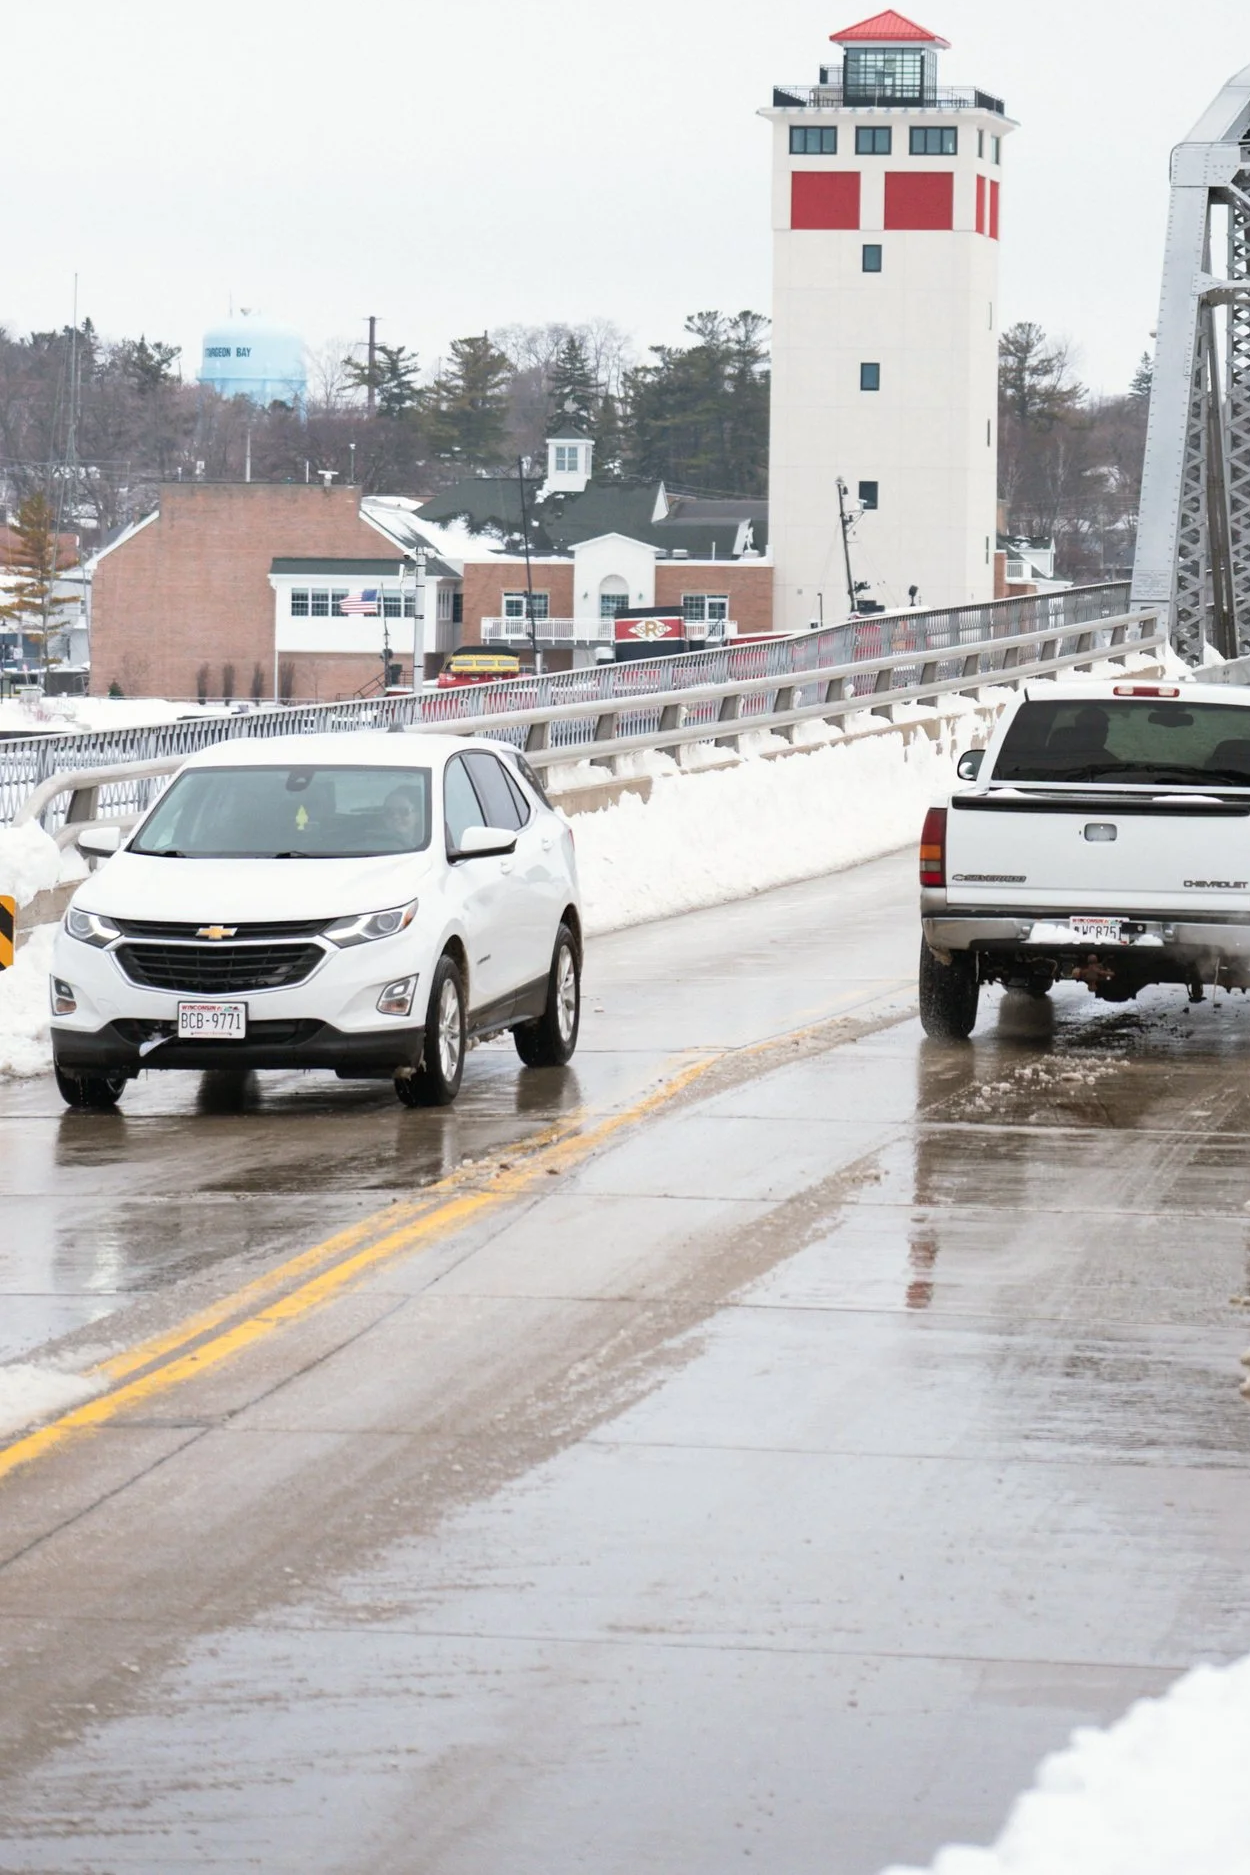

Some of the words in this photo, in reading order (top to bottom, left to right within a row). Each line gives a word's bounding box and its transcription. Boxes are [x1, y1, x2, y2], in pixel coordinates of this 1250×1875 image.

[236, 347, 252, 358] BAY
[1183, 880, 1249, 889] CHEVROLET
[181, 1012, 242, 1030] BCB-9771
